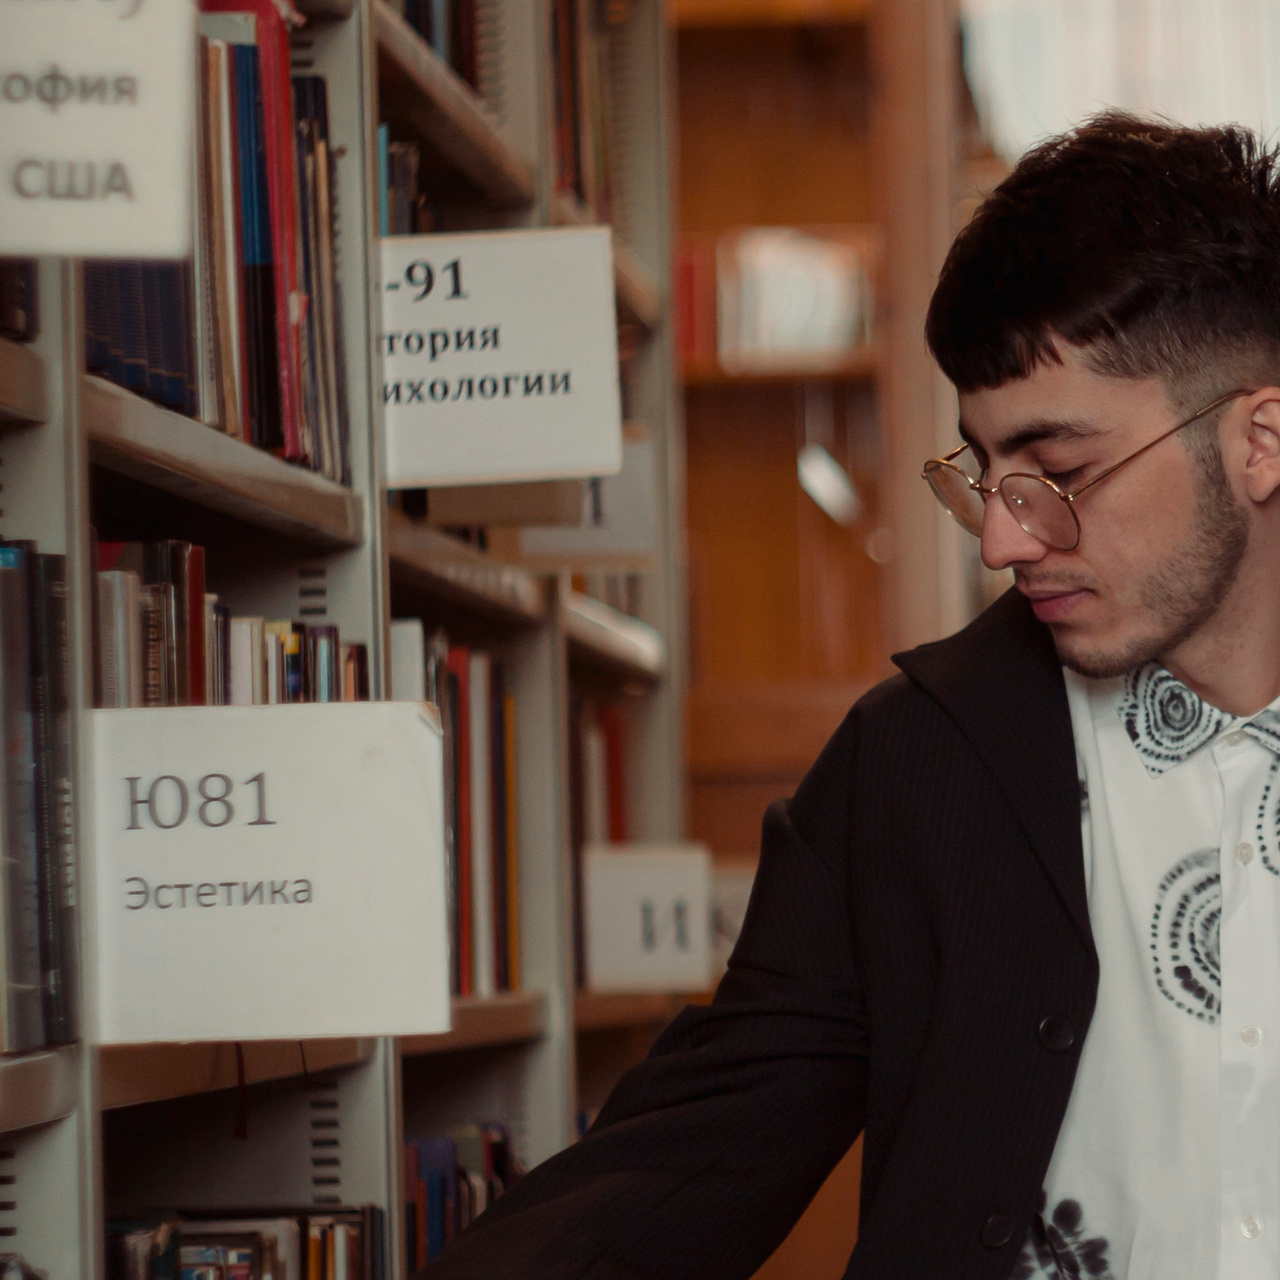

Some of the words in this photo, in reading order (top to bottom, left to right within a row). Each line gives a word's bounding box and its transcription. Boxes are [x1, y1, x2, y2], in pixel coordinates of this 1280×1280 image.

[11, 157, 136, 202] США
[123, 771, 277, 831] Ю81
[124, 876, 313, 911] Эстетика
